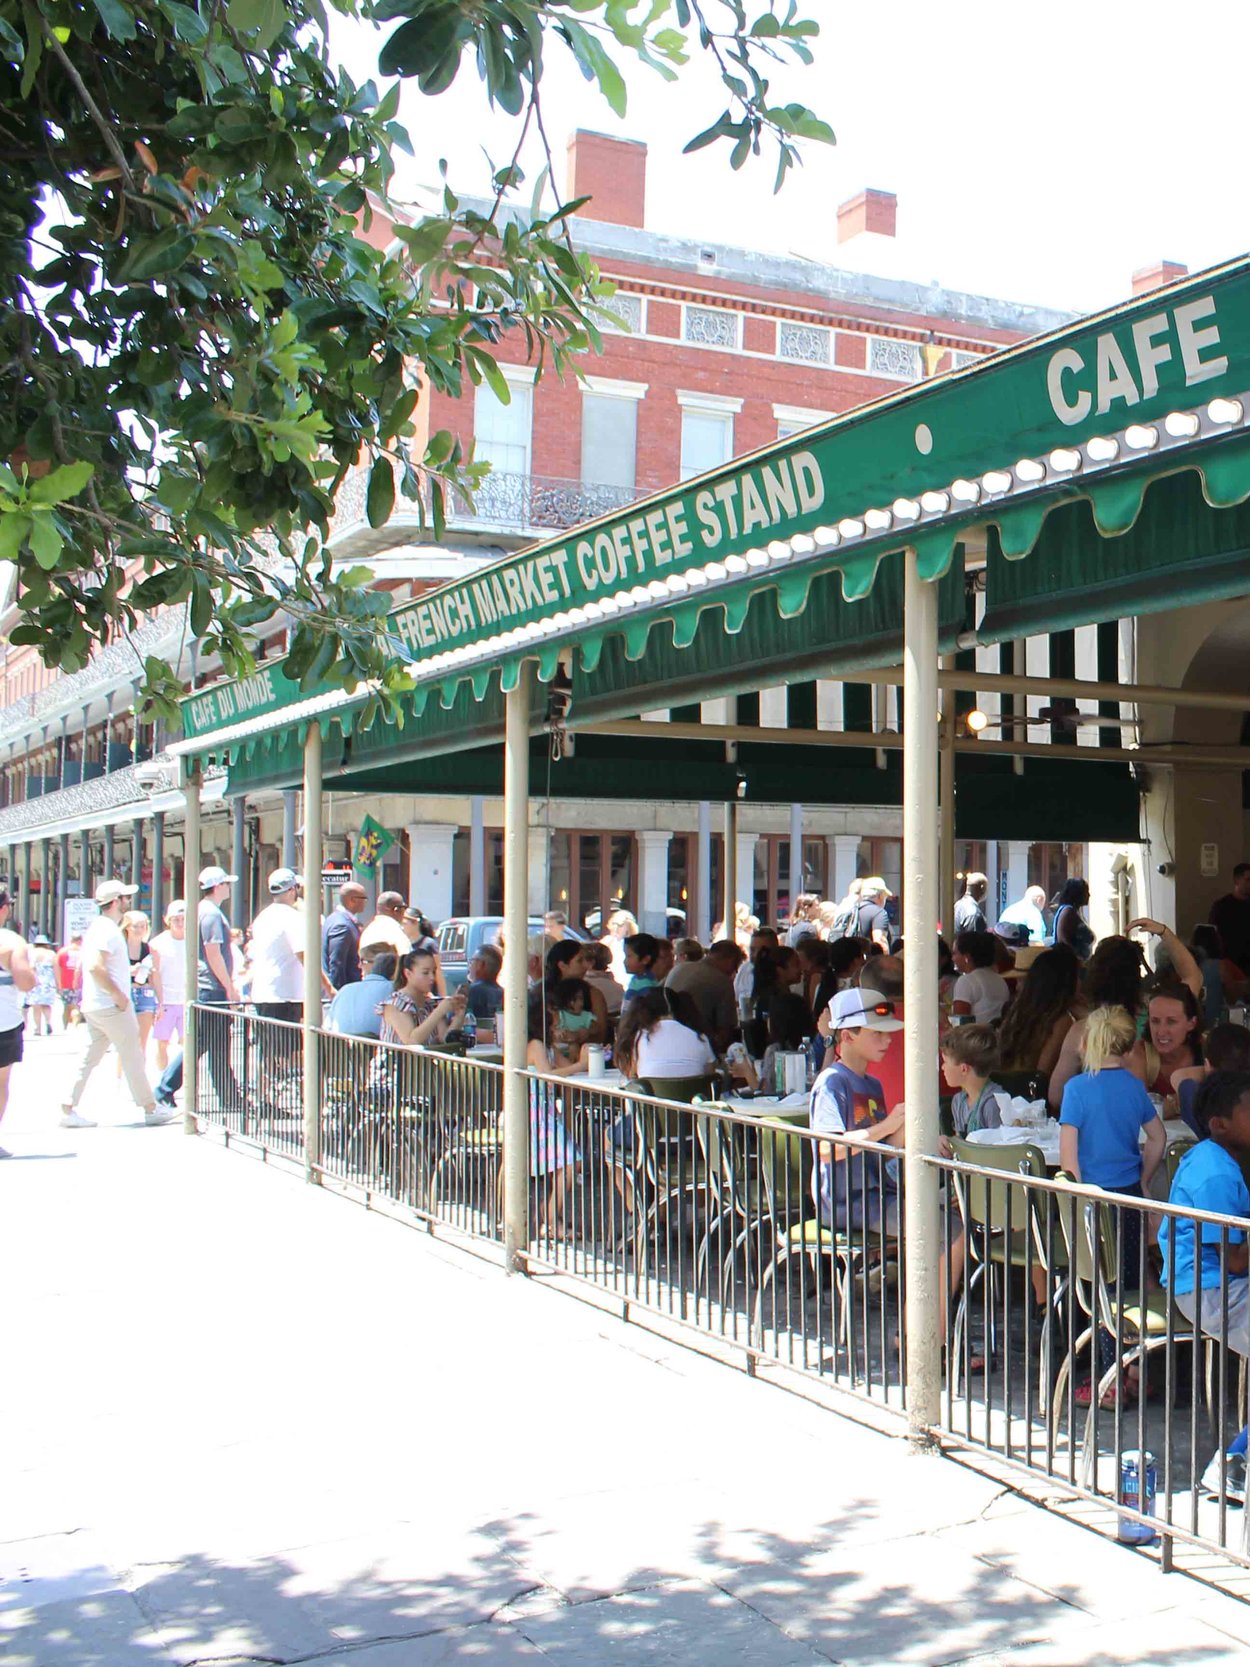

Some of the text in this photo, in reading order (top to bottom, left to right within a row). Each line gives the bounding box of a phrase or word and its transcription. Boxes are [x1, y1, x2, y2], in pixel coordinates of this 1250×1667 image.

[1046, 294, 1229, 427] CAFE
[395, 587, 476, 651] FRENCH
[471, 549, 571, 627] MARKET
[576, 501, 693, 591] COFFEE
[696, 451, 825, 549] STAND
[190, 670, 276, 729] CAFE DU MONDE
